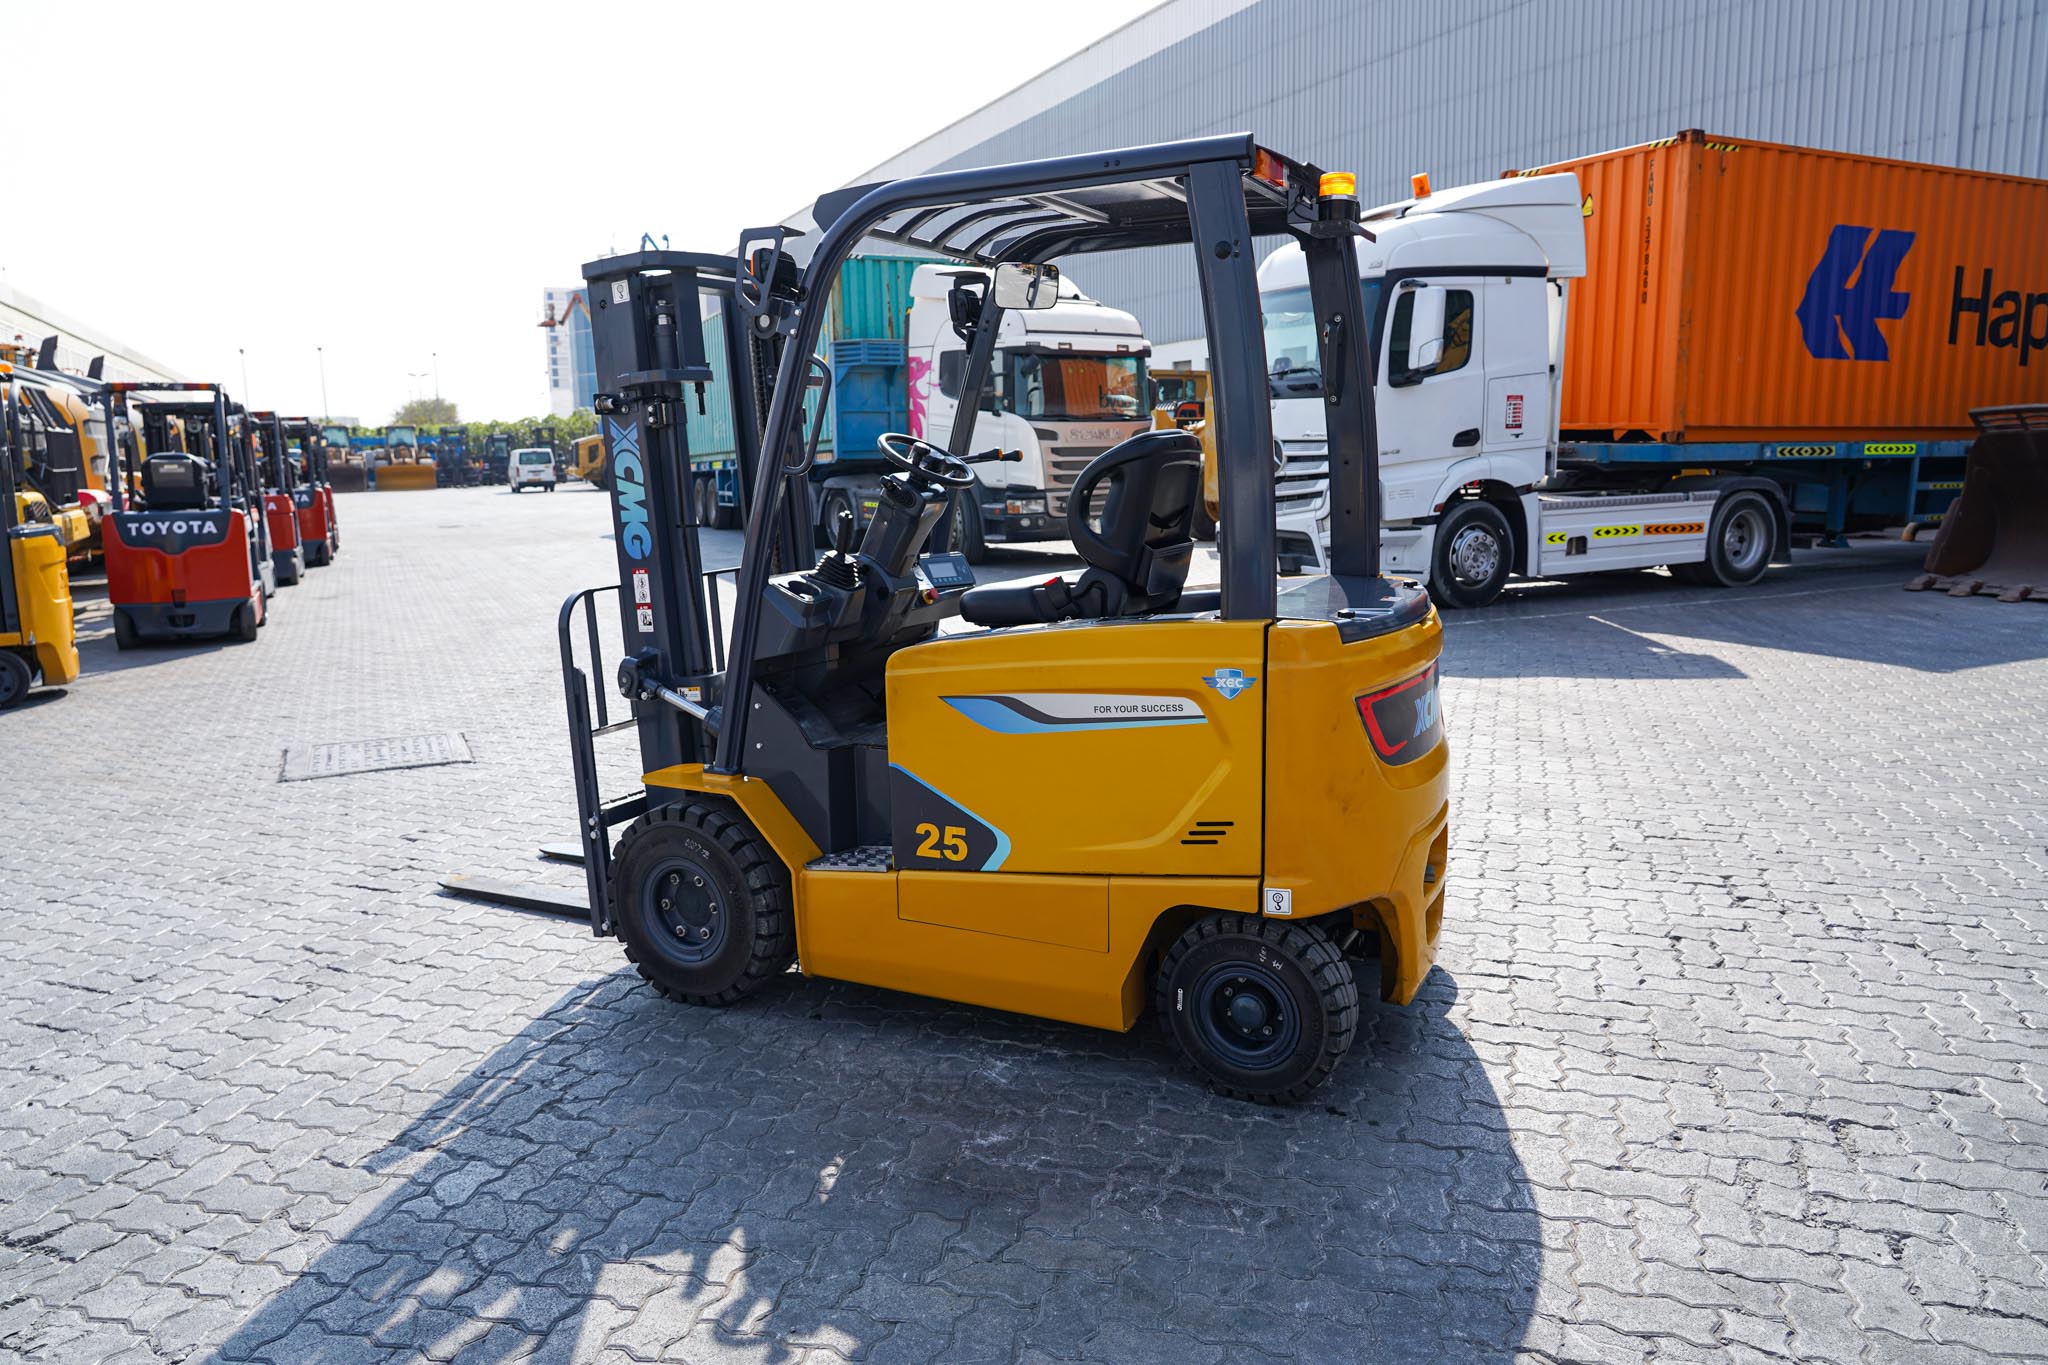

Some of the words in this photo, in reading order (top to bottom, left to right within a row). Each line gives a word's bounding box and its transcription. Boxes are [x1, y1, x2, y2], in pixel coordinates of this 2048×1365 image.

[608, 416, 652, 560] XCMG
[127, 520, 218, 537] TOYOTA
[1093, 705, 1112, 714] FOR
[1113, 705, 1139, 713] YOUR
[1140, 704, 1184, 713] SUCCESS
[915, 822, 968, 862] 25
